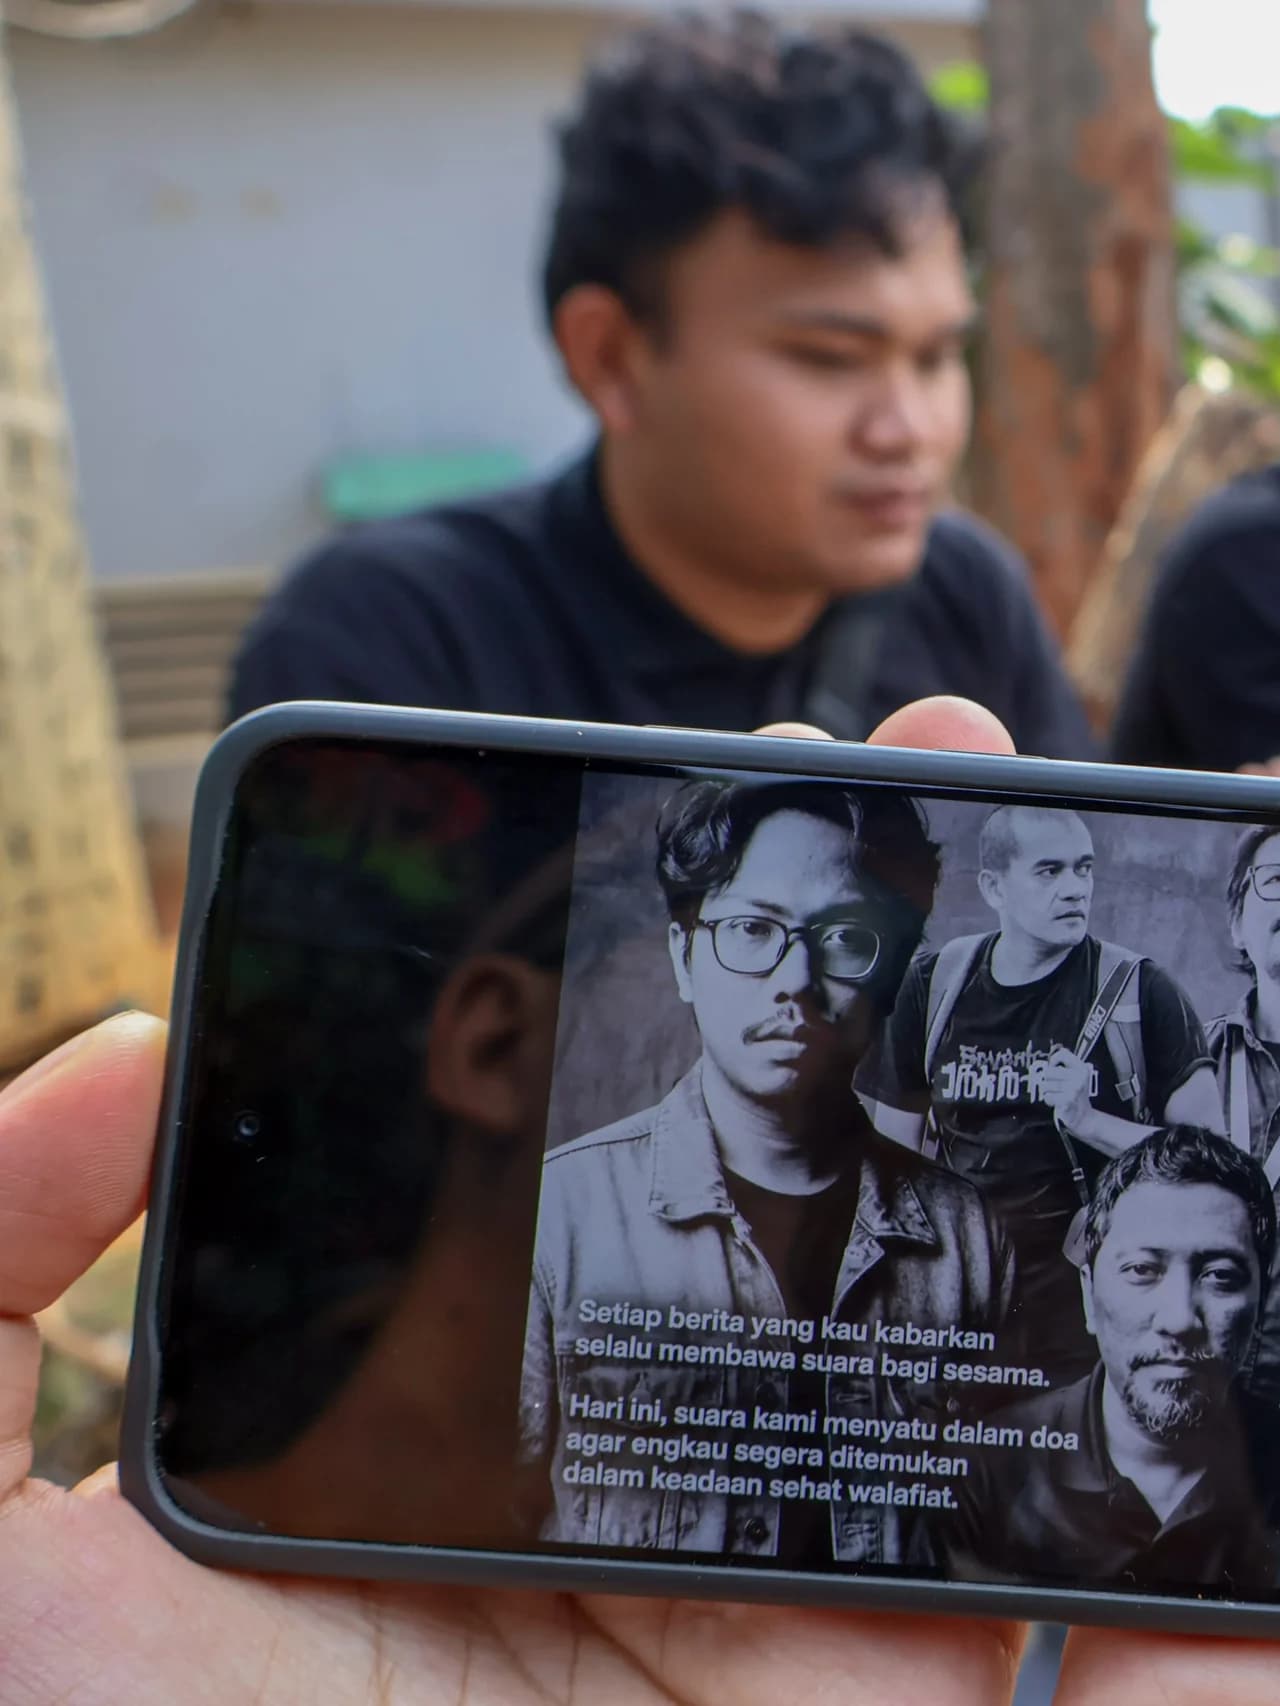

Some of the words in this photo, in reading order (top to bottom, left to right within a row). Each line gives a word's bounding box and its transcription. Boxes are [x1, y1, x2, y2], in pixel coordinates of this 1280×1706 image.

[578, 1299, 662, 1331] Setiap
[668, 1305, 744, 1333] berita
[750, 1316, 815, 1343] yang
[821, 1315, 867, 1342] kau
[874, 1319, 995, 1351] kabarkan
[575, 1334, 651, 1360] selalu
[658, 1343, 796, 1370] membawa
[801, 1353, 874, 1375] suara
[881, 1353, 937, 1384] bagi
[943, 1363, 1050, 1387] sesama.
[569, 1393, 624, 1419] Hari
[629, 1397, 667, 1427] ini,
[674, 1405, 746, 1429] suara
[753, 1405, 817, 1433] kami
[823, 1416, 937, 1442] menyatu
[943, 1419, 1023, 1447] dalam
[1030, 1426, 1079, 1450] doa
[566, 1431, 626, 1456] agar
[631, 1433, 728, 1462] engkau
[734, 1443, 823, 1469] segera
[830, 1445, 968, 1476] ditemukan
[562, 1460, 644, 1488] dalam
[650, 1465, 762, 1496] keadaan
[769, 1475, 842, 1501] sehat
[848, 1480, 959, 1509] walafiat.
